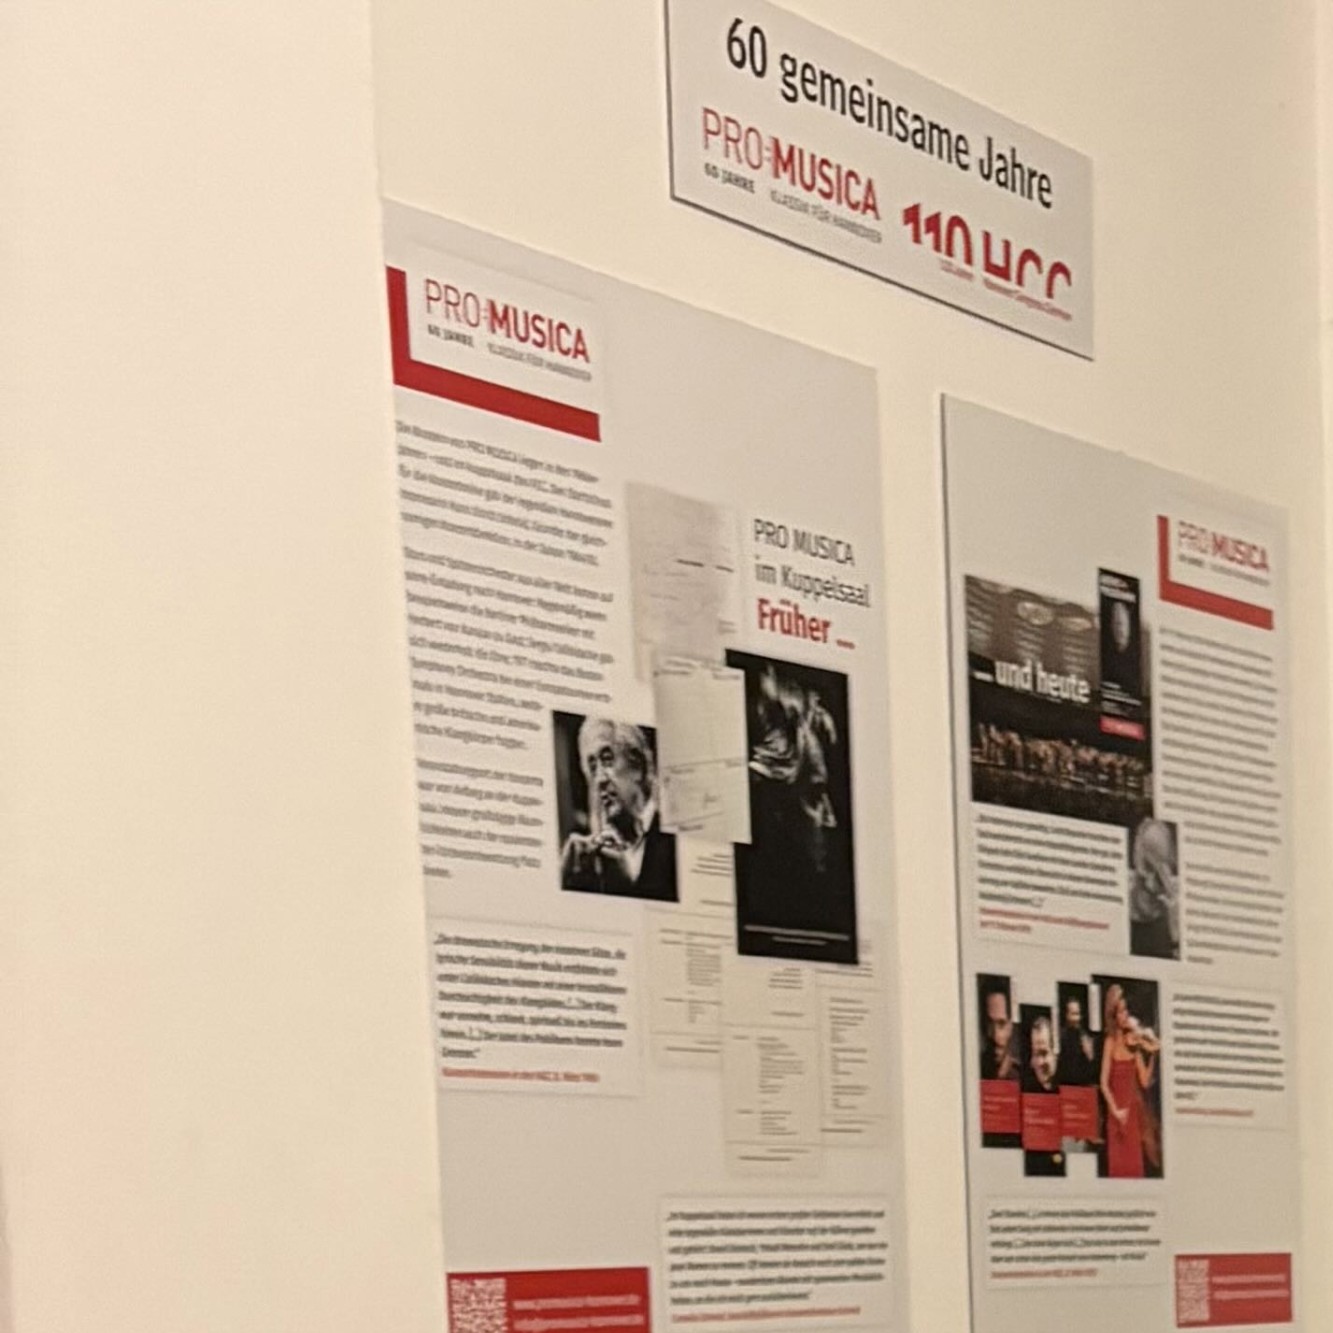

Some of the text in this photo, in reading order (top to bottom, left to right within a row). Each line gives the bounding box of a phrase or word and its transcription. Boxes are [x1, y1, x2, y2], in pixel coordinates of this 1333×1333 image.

[727, 17, 1052, 209] 60 gemeinsame Jahre
[754, 518, 855, 566] PRO MUSICA
[755, 555, 777, 585] im
[757, 598, 831, 643] Früher
[995, 659, 1091, 703] und heute
